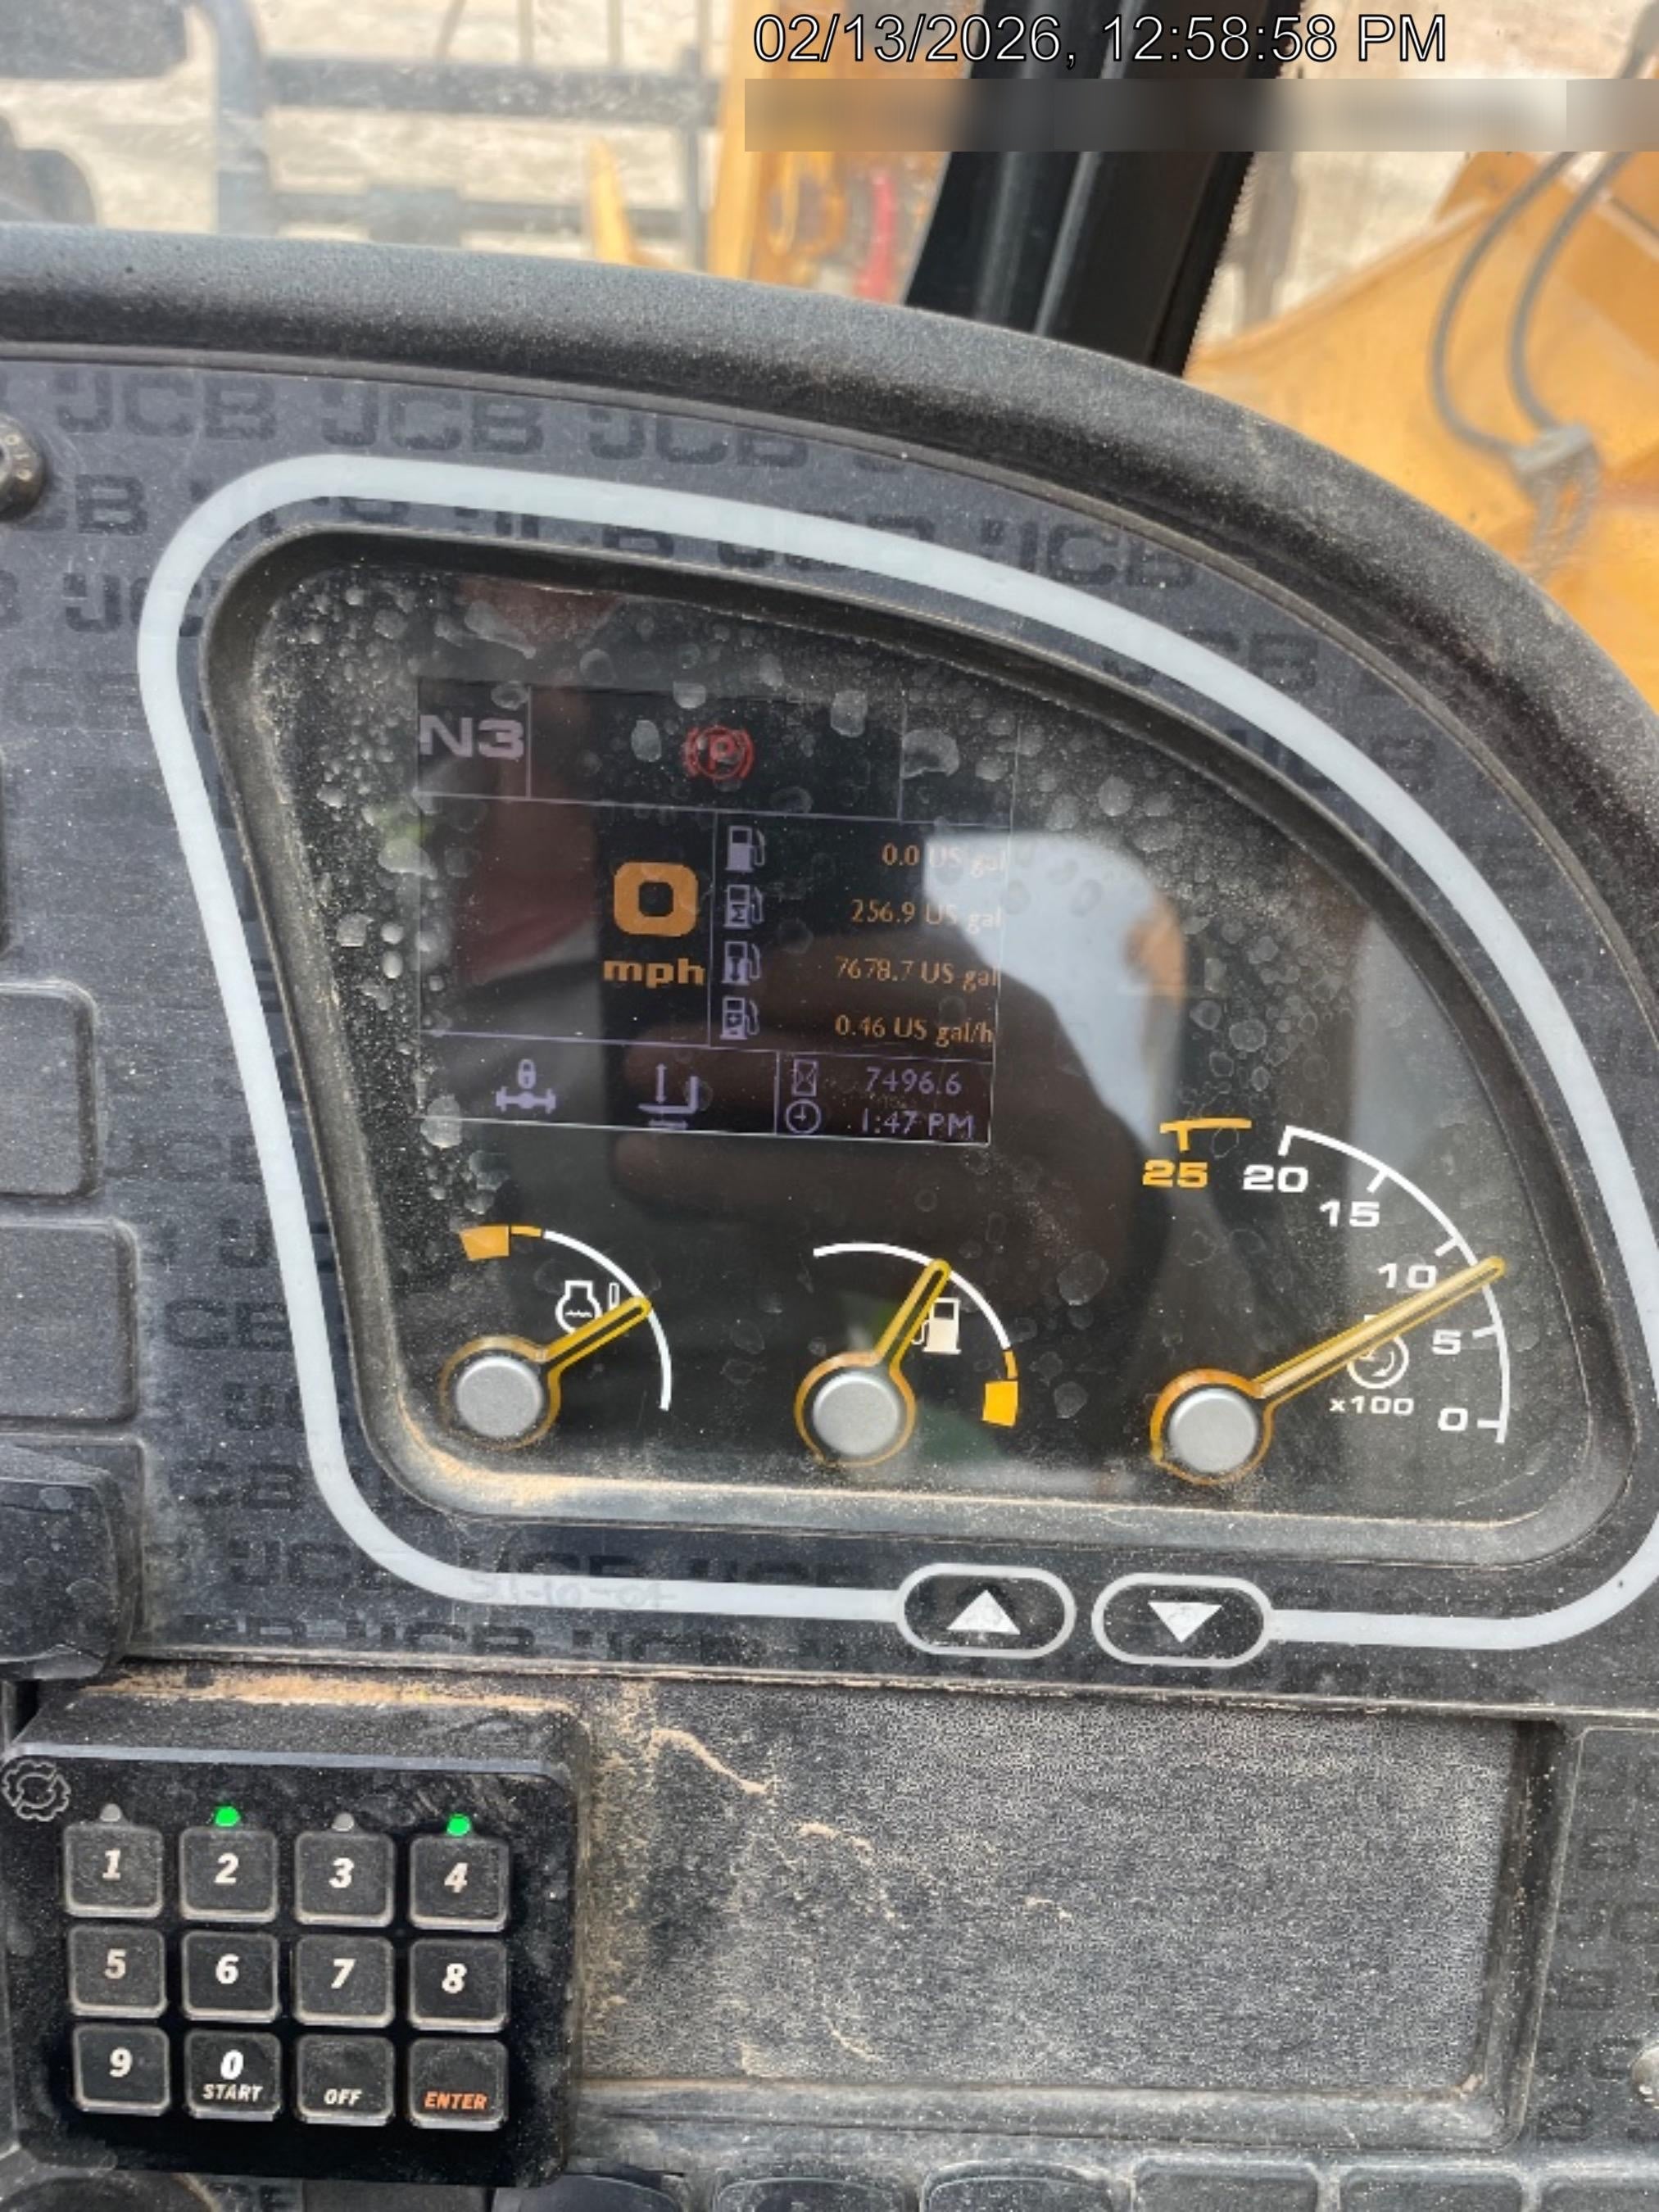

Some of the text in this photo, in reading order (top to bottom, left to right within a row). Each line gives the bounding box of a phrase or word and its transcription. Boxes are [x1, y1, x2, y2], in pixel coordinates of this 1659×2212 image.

[419, 714, 524, 760] N3
[882, 842, 921, 867] 0.0
[614, 861, 698, 937] 0
[850, 899, 1002, 934] 256.9 US gal
[604, 958, 705, 989] mph
[834, 955, 998, 993] 7678.7 US gal
[834, 1014, 995, 1047] 0.46 US gal/h
[864, 1066, 962, 1096] 7496.6
[862, 1108, 975, 1140] 1:47 PM
[1142, 1159, 1208, 1189] 25
[1243, 1164, 1309, 1193] 20
[1319, 1200, 1380, 1227] 15
[1377, 1262, 1437, 1290] 10
[1432, 1330, 1462, 1356] 5
[1329, 1397, 1414, 1416] x100
[1438, 1407, 1469, 1431] 0
[101, 1849, 121, 1881] 1
[214, 1852, 239, 1884] 2
[329, 1857, 355, 1888] 3
[444, 1862, 469, 1893] 4
[104, 1949, 126, 1979] 5
[215, 1953, 240, 1984] 6
[330, 1958, 356, 1989] 7
[441, 1963, 467, 1994] 8
[109, 2048, 133, 2078] 9
[220, 2050, 244, 2080] 0
[202, 2083, 263, 2102] START
[324, 2088, 362, 2106] OFF
[424, 2092, 489, 2110] ENTER
